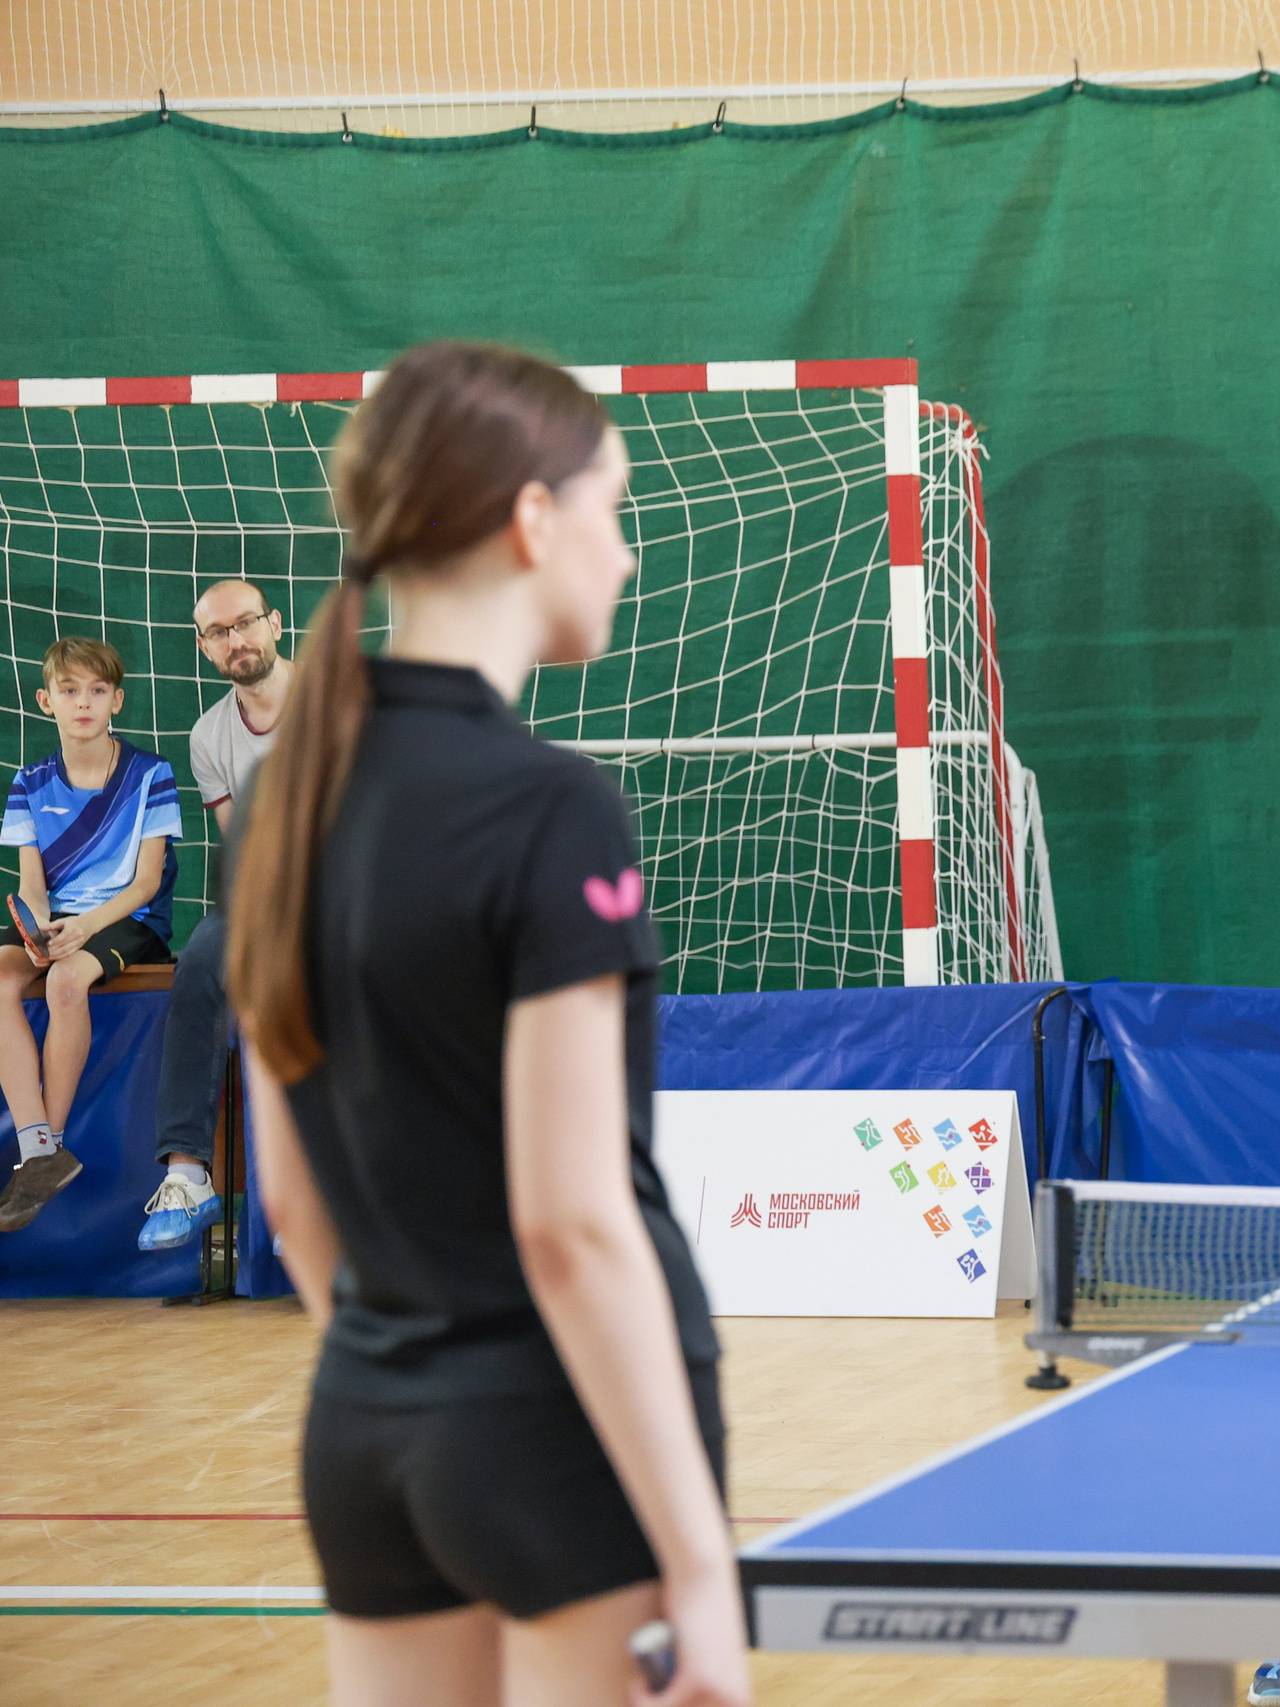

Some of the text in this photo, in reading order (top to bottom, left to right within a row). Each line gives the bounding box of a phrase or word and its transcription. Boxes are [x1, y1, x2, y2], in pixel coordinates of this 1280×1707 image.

[769, 1189, 860, 1210] МОСКОВСКИЙ
[768, 1212, 810, 1229] СПОРТ
[833, 1606, 1068, 1640] START LINE
